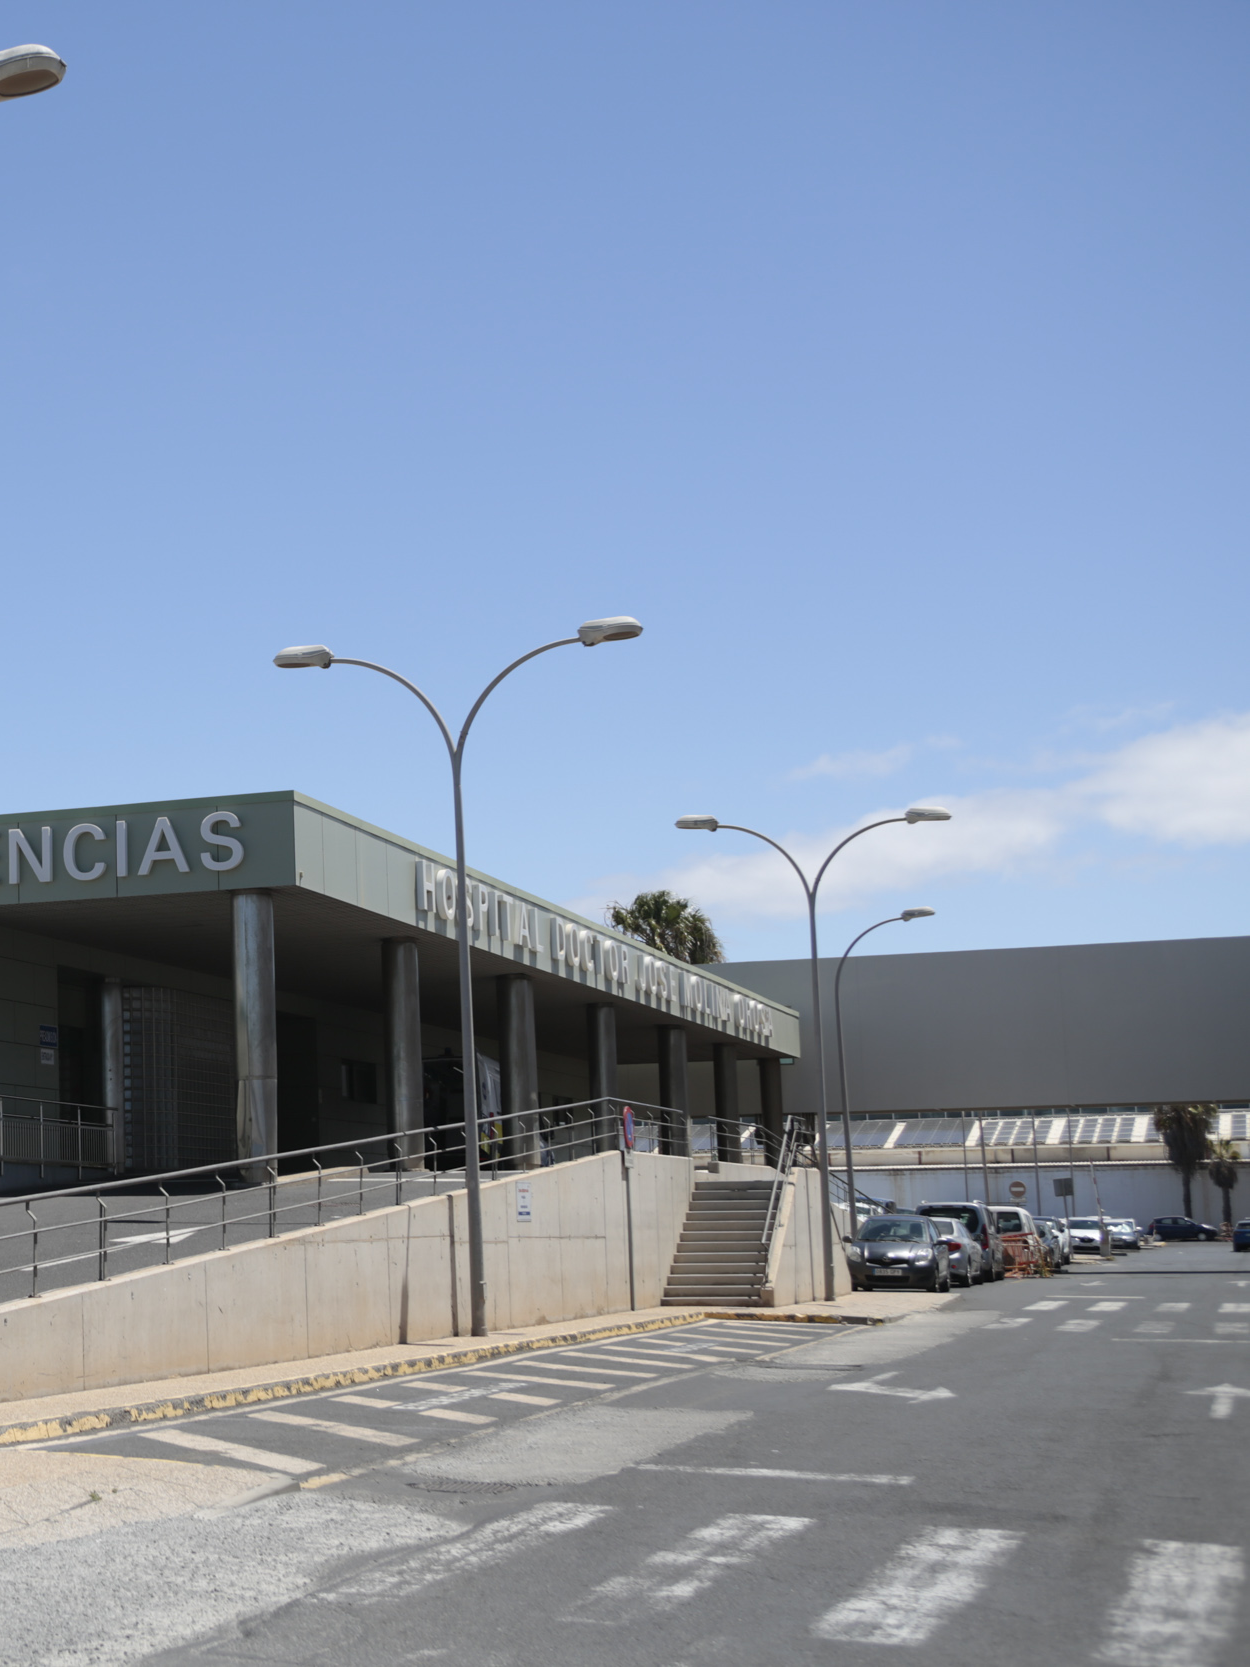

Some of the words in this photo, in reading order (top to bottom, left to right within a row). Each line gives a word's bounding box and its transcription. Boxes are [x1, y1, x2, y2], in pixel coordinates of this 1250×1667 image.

[415, 859, 544, 953] HOSPITAL
[550, 917, 630, 985] DOCTOR
[635, 954, 677, 1002] JOSE
[679, 970, 733, 1023] MOLINA
[733, 994, 773, 1037] OROSA
